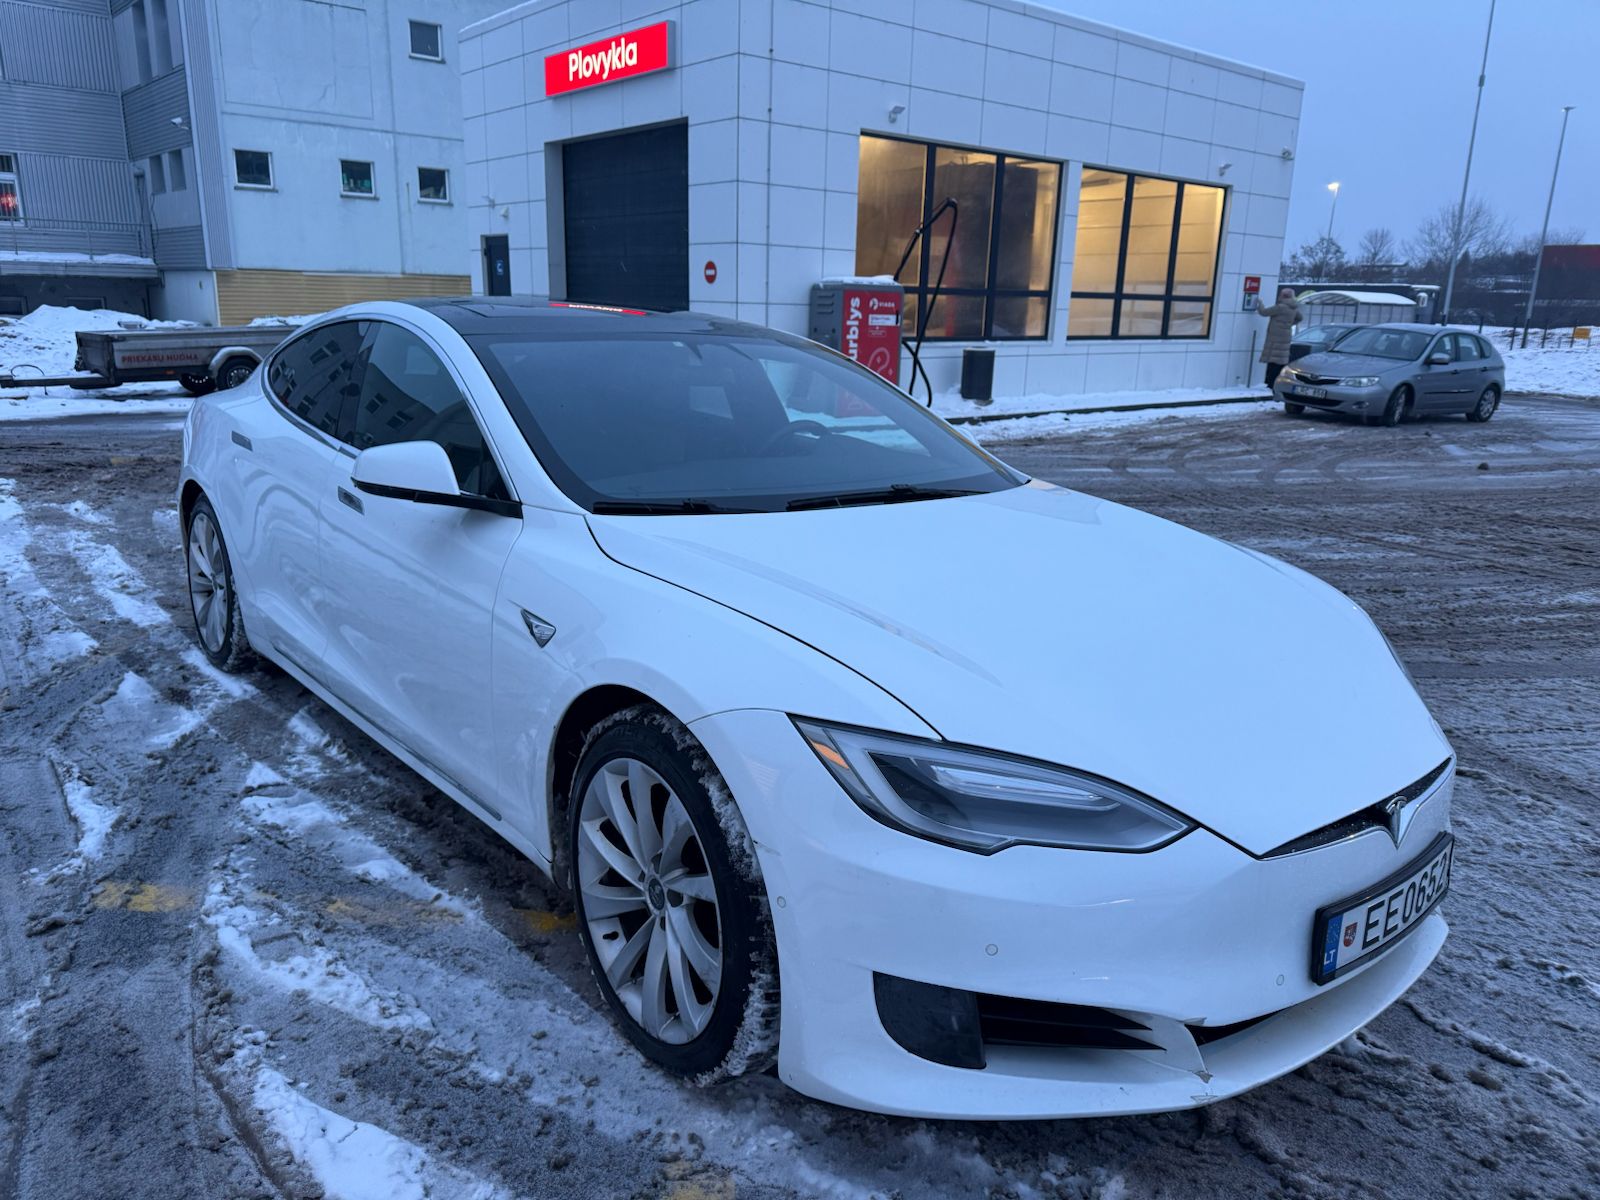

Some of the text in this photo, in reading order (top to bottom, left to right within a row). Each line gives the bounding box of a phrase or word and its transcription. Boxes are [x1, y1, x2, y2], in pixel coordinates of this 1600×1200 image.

[568, 37, 638, 82] Plovykla
[1361, 851, 1448, 950] EE0652
[1323, 949, 1335, 966] LT
